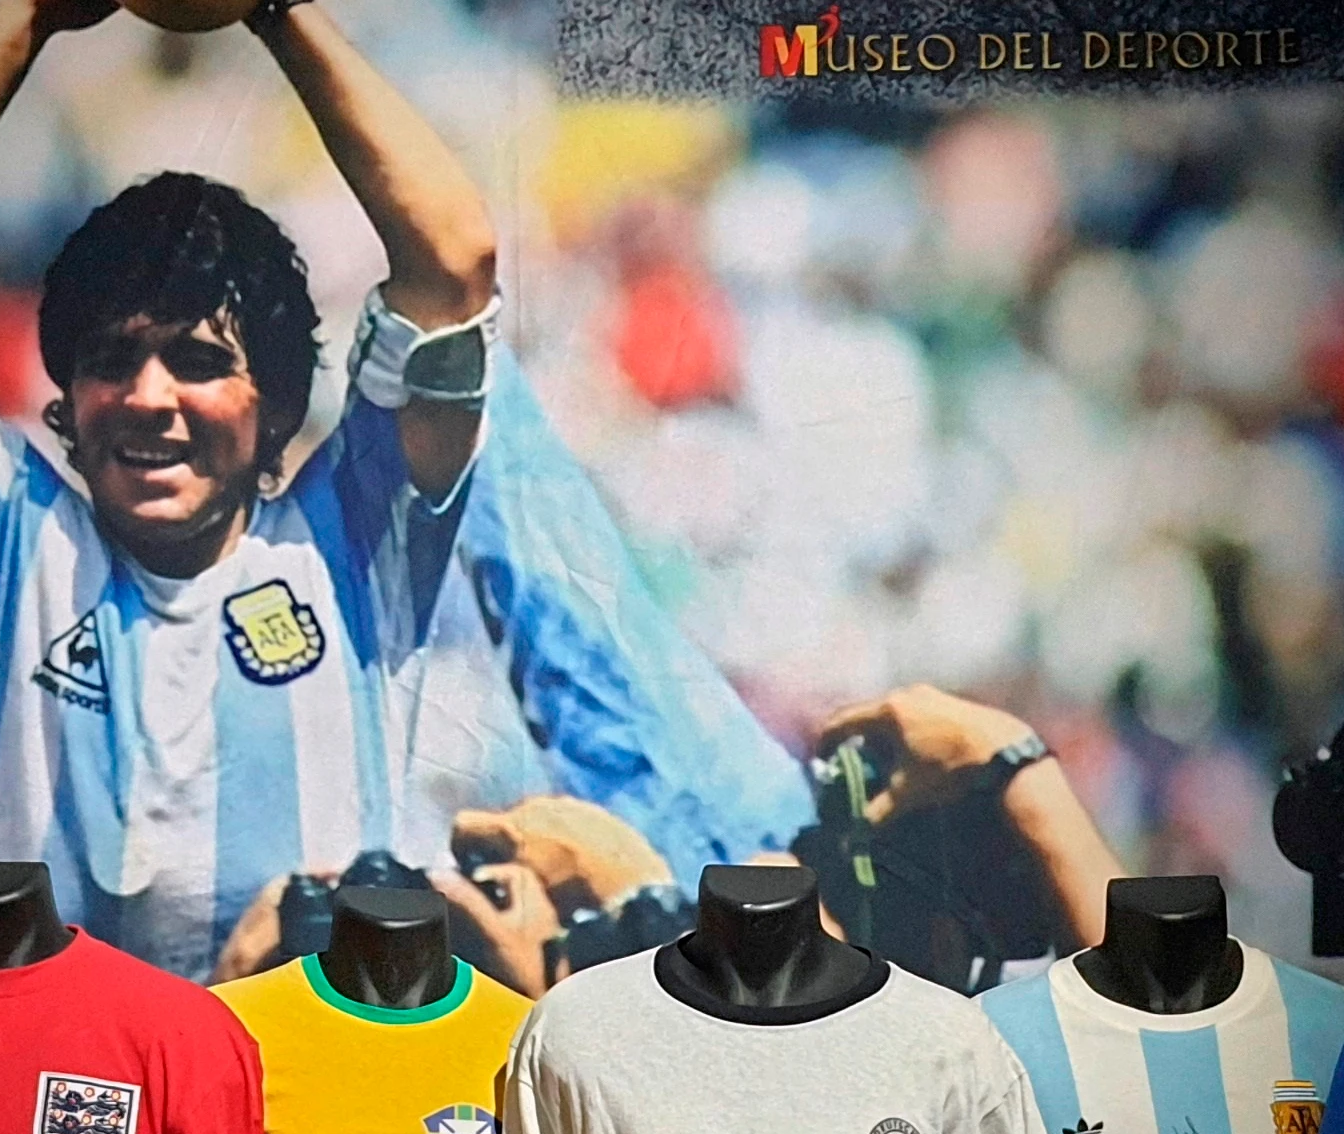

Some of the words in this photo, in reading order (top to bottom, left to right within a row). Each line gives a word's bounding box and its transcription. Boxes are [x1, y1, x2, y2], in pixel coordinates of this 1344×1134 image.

[760, 24, 956, 77] MUSEO
[978, 32, 1062, 71] DEL
[1082, 28, 1300, 69] DEPORTE
